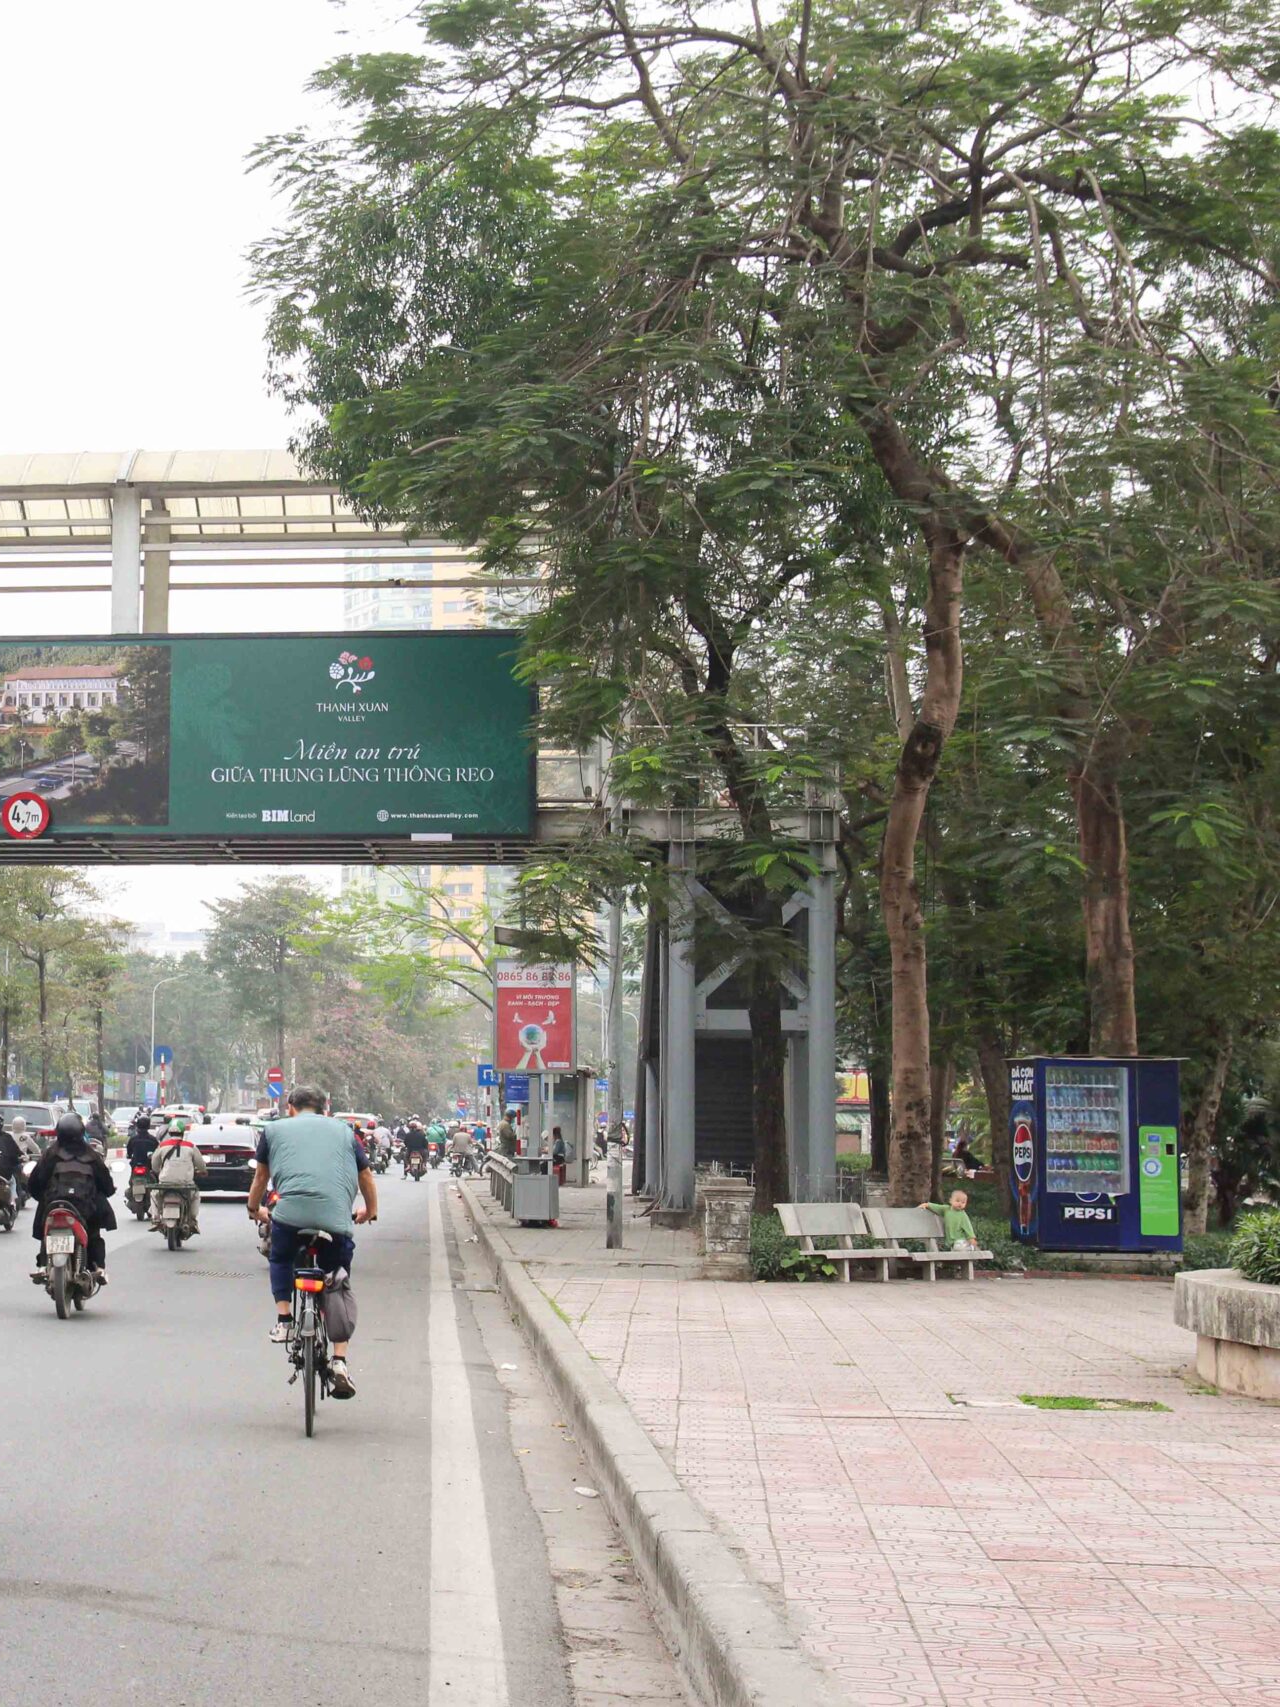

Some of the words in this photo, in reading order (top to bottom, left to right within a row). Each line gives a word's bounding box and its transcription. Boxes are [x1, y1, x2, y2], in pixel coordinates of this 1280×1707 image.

[316, 702, 355, 713] THANH
[358, 702, 389, 713] XUAN
[337, 715, 366, 723] VALLEY
[283, 738, 348, 761] Miền
[354, 747, 381, 761] an
[387, 743, 421, 761] trú
[210, 766, 255, 783] GIỮA
[260, 767, 324, 783] THUNG
[327, 765, 380, 783] LŨNG
[383, 764, 452, 783] THÔNG
[455, 767, 495, 783] REO
[261, 809, 289, 822] BIM
[289, 809, 316, 823] Land
[390, 811, 479, 820] www.thanhxuanvalley.com
[497, 972, 523, 981] 0865
[526, 972, 539, 981] 86
[558, 972, 571, 981] 86
[1014, 1146, 1032, 1159] PEPSI
[1064, 1206, 1112, 1220] PEPSI
